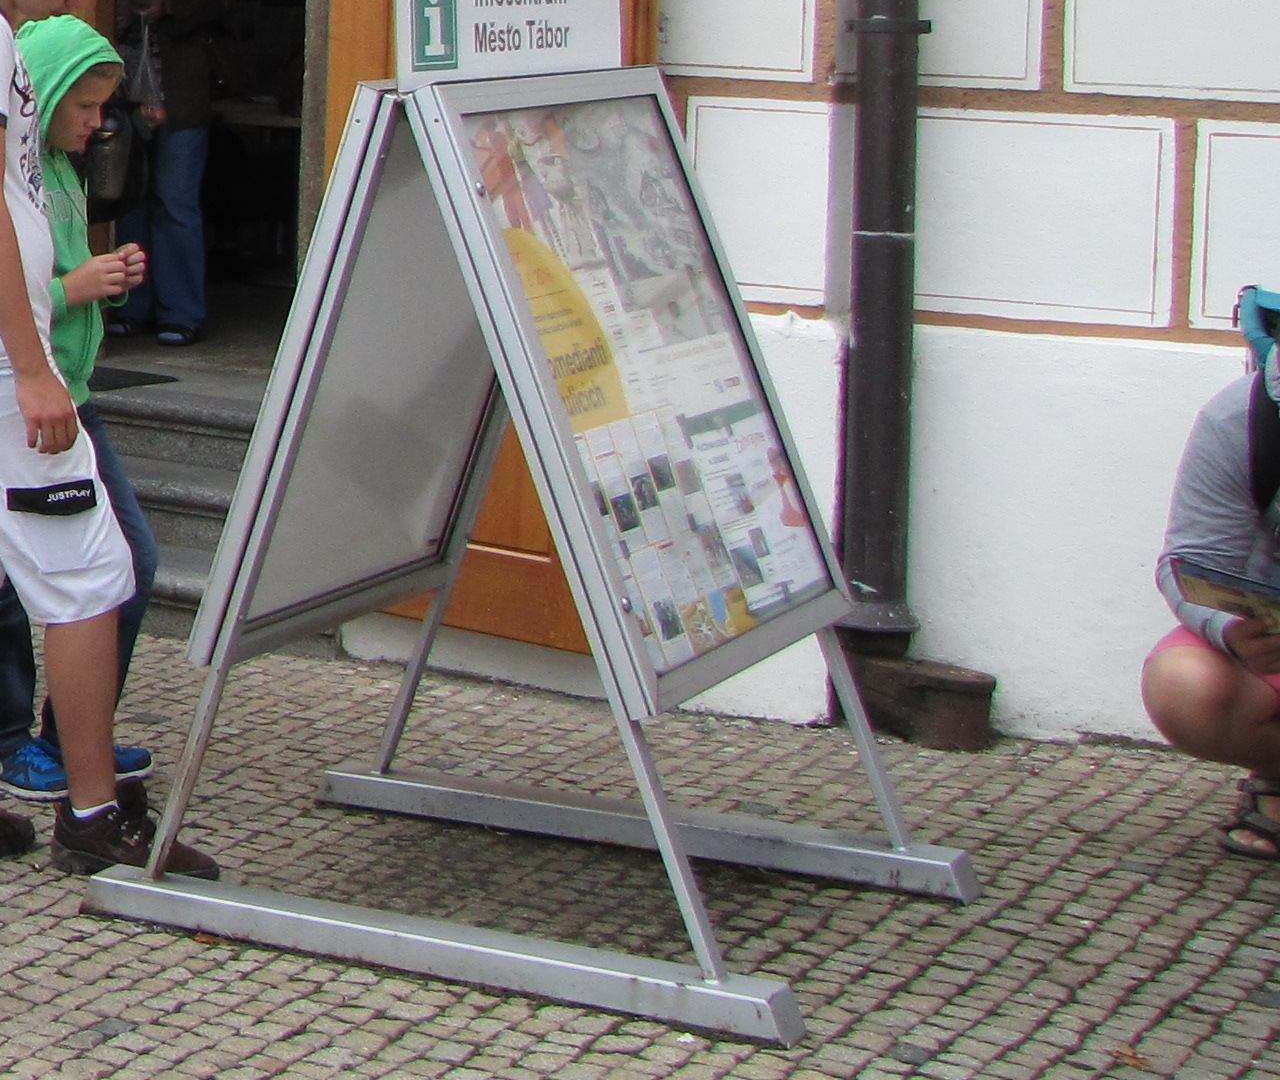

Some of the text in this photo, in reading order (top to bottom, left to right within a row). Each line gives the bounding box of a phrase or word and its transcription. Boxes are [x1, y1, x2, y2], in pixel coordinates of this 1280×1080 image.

[474, 19, 570, 53] Město Tábor
[46, 488, 92, 503] JUSTPLAY
